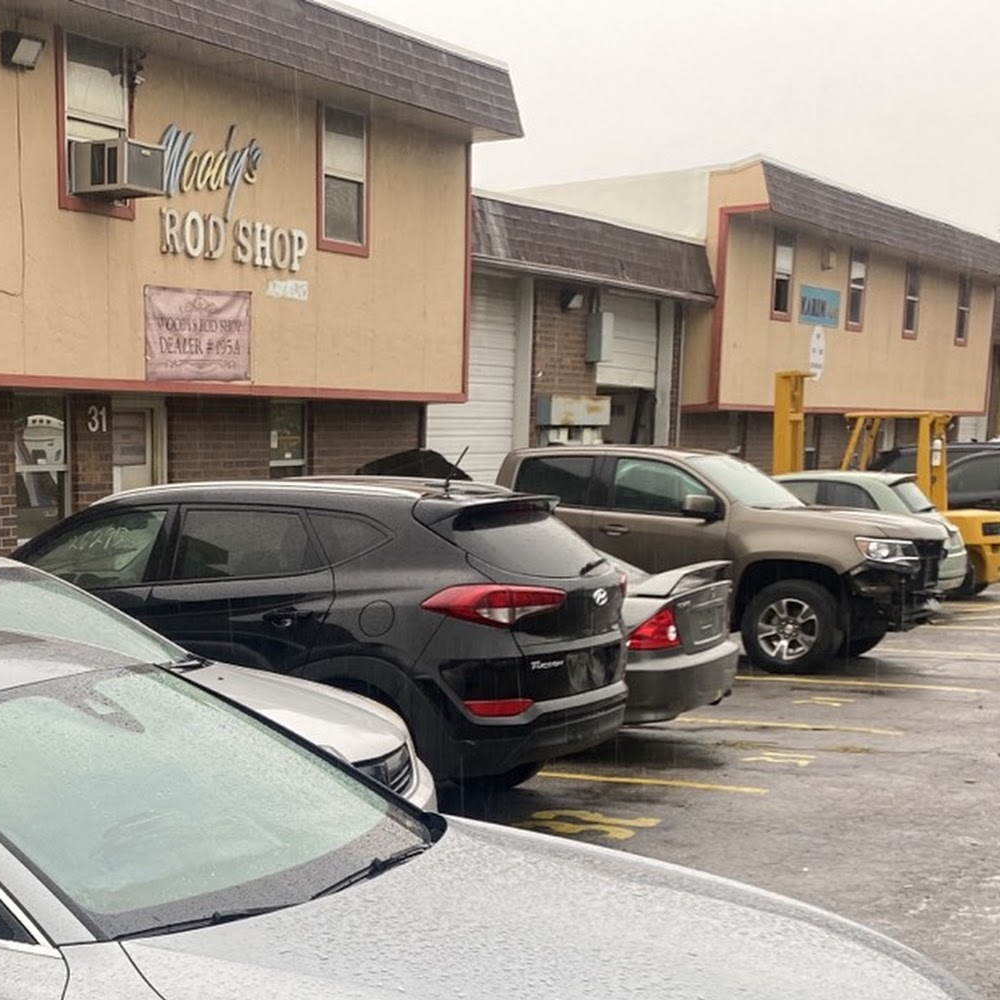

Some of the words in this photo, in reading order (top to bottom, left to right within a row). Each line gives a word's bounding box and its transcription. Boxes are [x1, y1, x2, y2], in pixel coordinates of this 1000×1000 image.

[160, 207, 226, 260] ROD
[233, 219, 308, 273] SHOP
[159, 336, 204, 356] DEALER
[87, 405, 107, 433] 31
